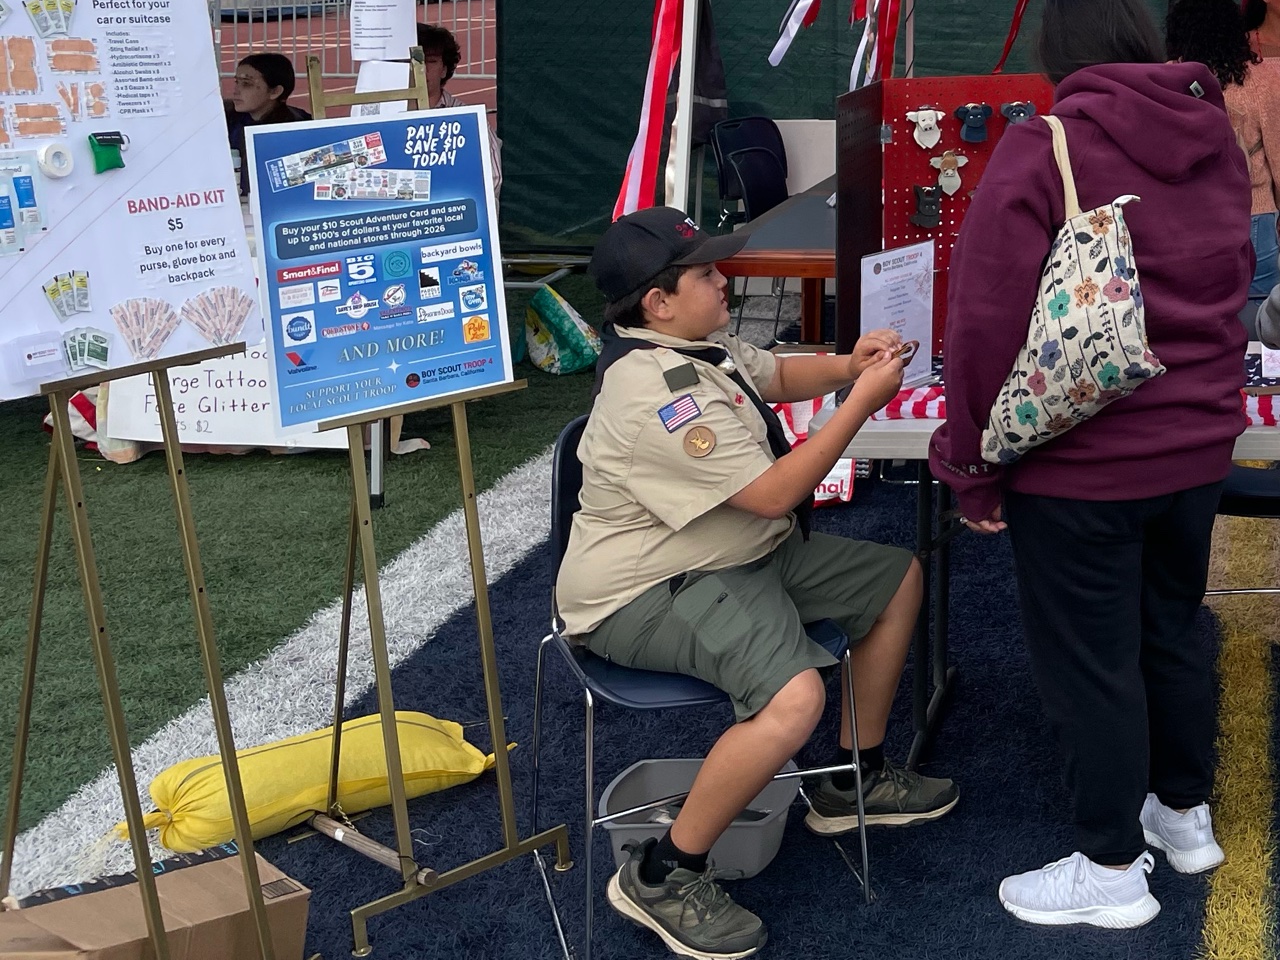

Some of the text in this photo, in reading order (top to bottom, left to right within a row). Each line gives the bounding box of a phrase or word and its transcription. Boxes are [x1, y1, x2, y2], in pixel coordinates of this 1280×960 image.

[92, 0, 170, 10] Perfect for your
[96, 14, 171, 24] car or suitcase
[407, 121, 461, 140] PAY $10
[404, 135, 466, 155] SAVE $10
[412, 150, 456, 168] TODAY
[127, 189, 225, 214] BAND-AID KIT
[167, 217, 184, 232] $5
[282, 204, 466, 236] Buy your $10 Scout Adventure Card and save
[288, 237, 299, 245] up
[301, 235, 310, 243] to
[312, 230, 339, 241] $100's
[341, 228, 350, 237] of
[352, 225, 380, 236] dollars
[392, 221, 410, 231] your
[412, 216, 442, 227] favorite
[444, 213, 464, 222] local
[144, 237, 226, 256] Buy one for every
[309, 225, 445, 251] and national stores through 2026
[346, 254, 374, 263] BIG
[421, 243, 482, 259] backyard bowls
[140, 249, 236, 274] purse, glove box and
[283, 262, 339, 280] Smart&Final
[348, 261, 375, 280] 5
[168, 268, 215, 283] backpack
[339, 330, 445, 362] AND MORE!
[421, 369, 437, 378] BOY
[438, 364, 462, 375] SCOUT
[463, 359, 486, 370] TROOP
[461, 368, 485, 377] California
[147, 369, 267, 394] Lrge Tattoo
[306, 377, 382, 400] SUPPORT YOUR
[198, 396, 271, 414] Glitter
[327, 392, 360, 406] SCOUT
[363, 385, 397, 399] TROOP
[196, 419, 213, 433] $2
